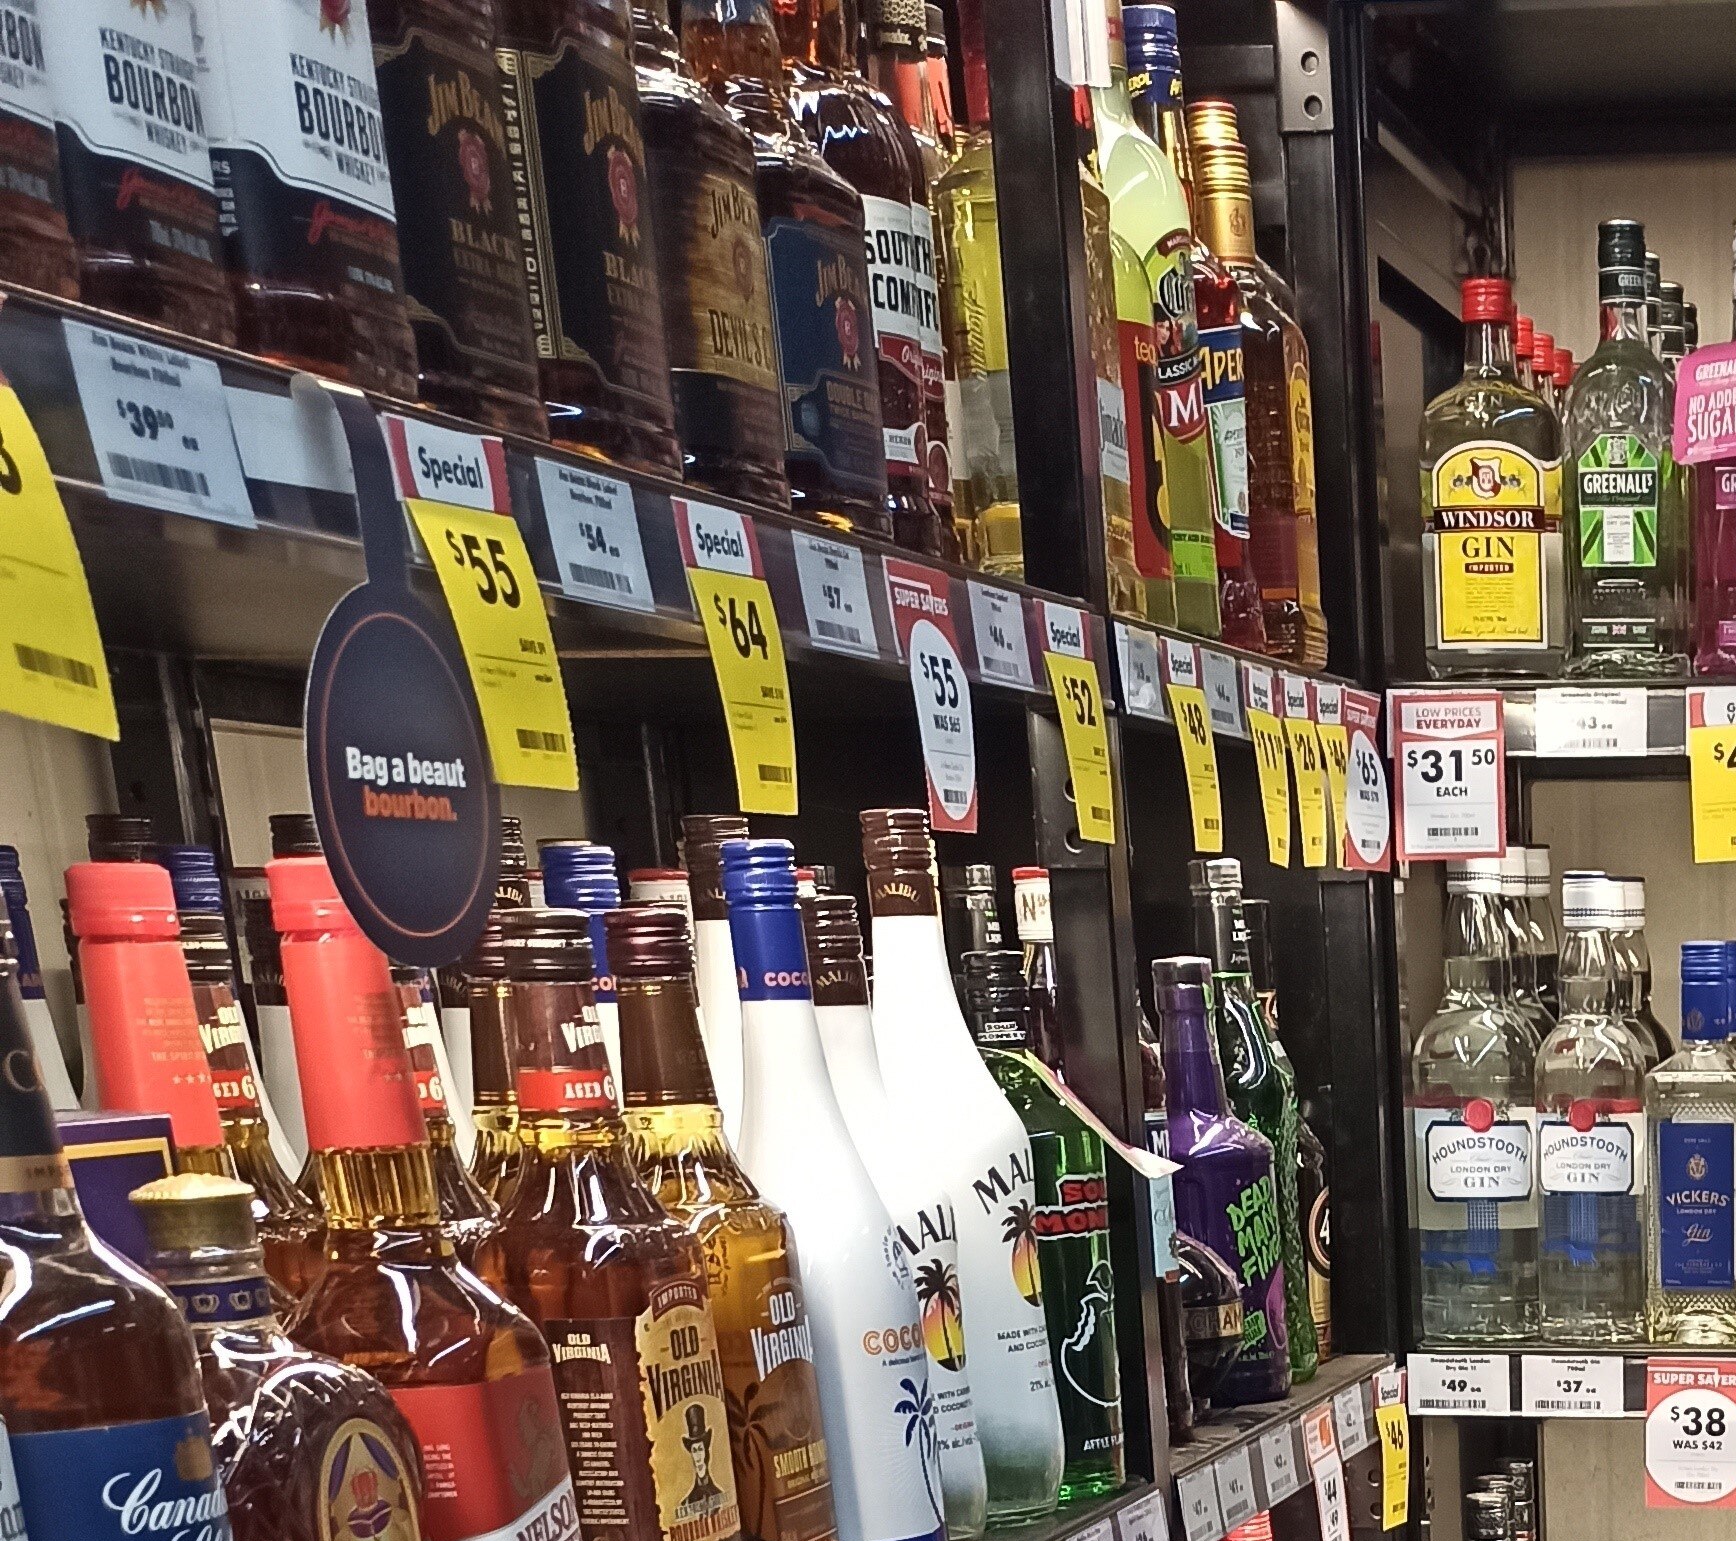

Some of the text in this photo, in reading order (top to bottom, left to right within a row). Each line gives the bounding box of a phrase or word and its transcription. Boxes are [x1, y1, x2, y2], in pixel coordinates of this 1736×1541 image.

[1688, 395, 1706, 413] NO
[418, 447, 483, 489] Special
[1441, 509, 1535, 530] WINDSOR
[696, 523, 745, 558] Special
[1461, 535, 1515, 558] GIN
[445, 530, 522, 609] $55
[714, 594, 769, 660] $64
[1049, 617, 1080, 649] Special
[920, 652, 959, 710] $55
[1062, 675, 1097, 730] $52
[1416, 706, 1482, 718] LOW PRICES
[1181, 700, 1207, 747] $48
[1416, 717, 1481, 730] EVERYDAY
[346, 746, 467, 789] Bag a beaut
[1436, 786, 1468, 797] EACH
[1431, 1136, 1529, 1164] HOUNDSTOOTH
[1543, 1135, 1628, 1162] HOUNDSTOOTH
[1463, 1176, 1501, 1188] GIN
[1567, 1172, 1600, 1183] GIN
[1240, 1176, 1272, 1224] DEAD
[1667, 1192, 1731, 1208] VICKERS
[669, 1323, 701, 1361] OLD
[751, 1314, 814, 1382] VIRGINIA
[647, 1358, 724, 1424] VIRGINIA
[1441, 1380, 1467, 1392] $49
[1654, 1372, 1694, 1387] SUPER
[1671, 1407, 1726, 1437] $38
[1673, 1439, 1722, 1451] WAS $42
